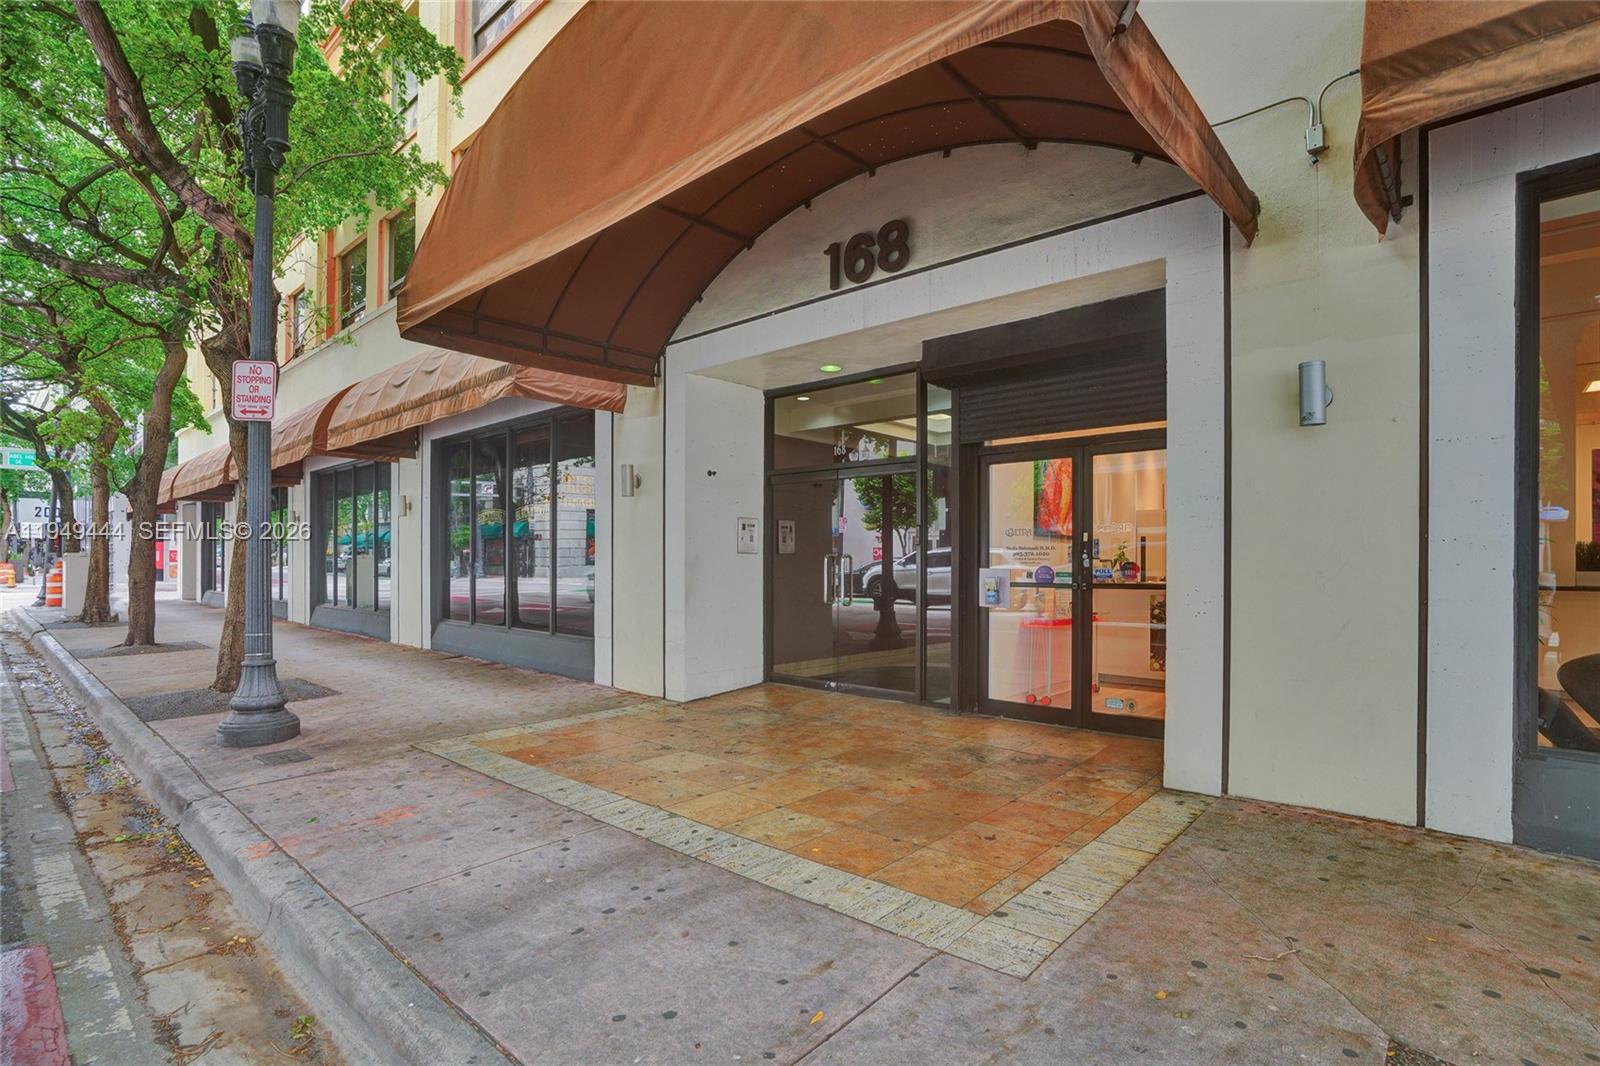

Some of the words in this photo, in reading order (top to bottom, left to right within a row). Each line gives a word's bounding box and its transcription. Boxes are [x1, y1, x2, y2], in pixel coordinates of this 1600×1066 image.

[823, 219, 910, 291] 168
[249, 366, 262, 375] NO
[237, 376, 272, 384] STOPPING
[248, 385, 260, 393] OR
[236, 395, 271, 403] STANDING
